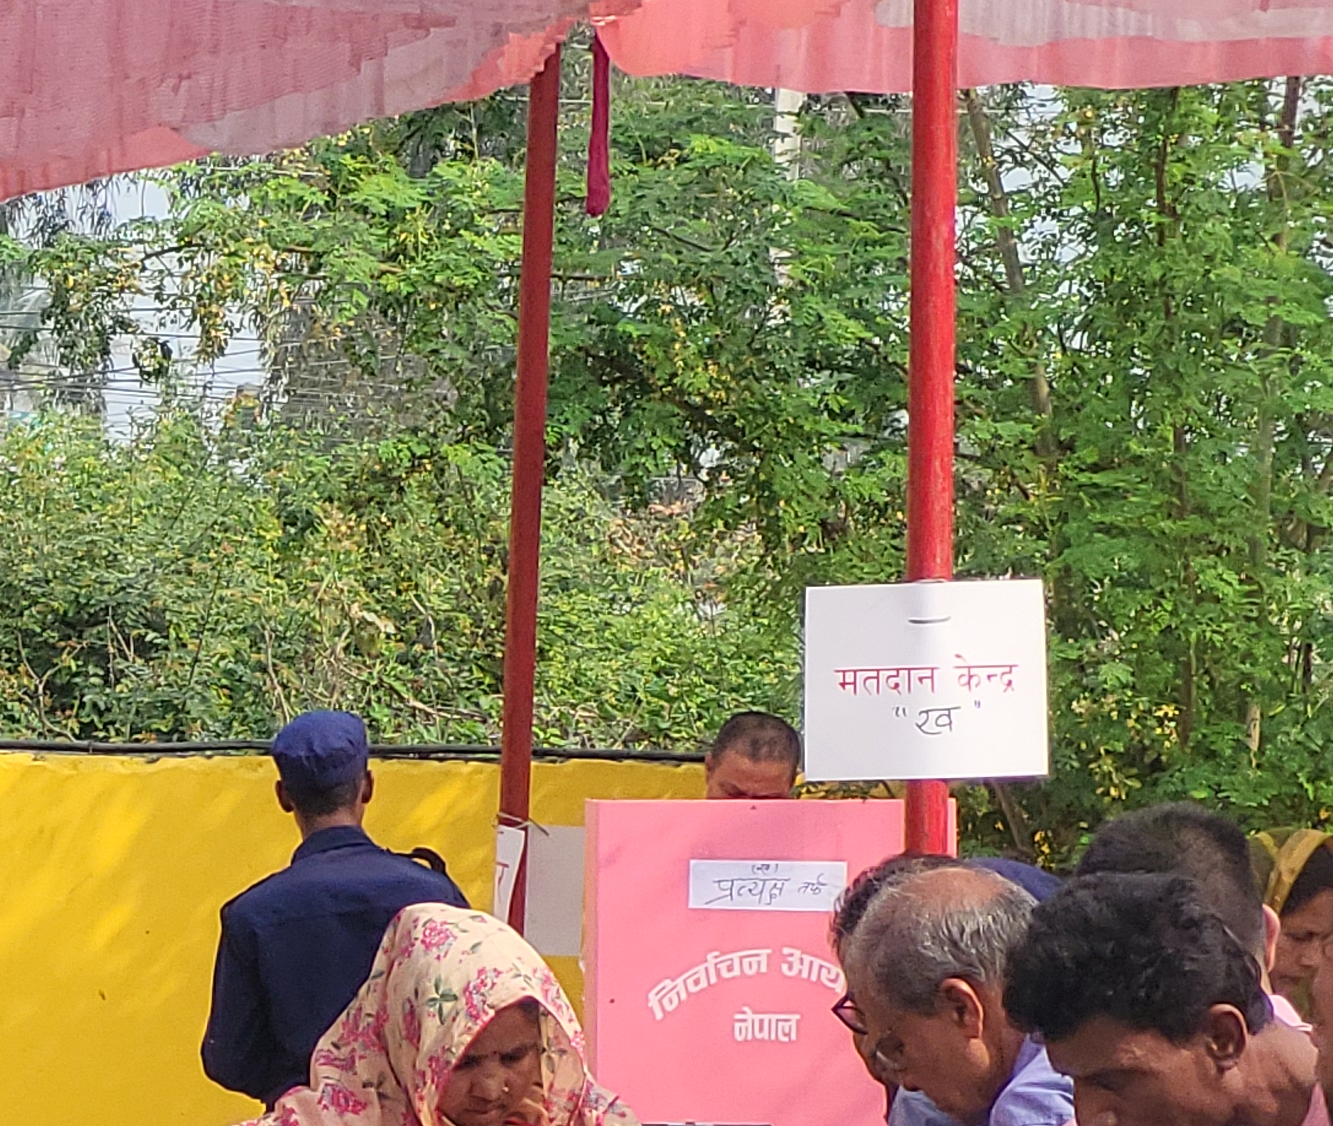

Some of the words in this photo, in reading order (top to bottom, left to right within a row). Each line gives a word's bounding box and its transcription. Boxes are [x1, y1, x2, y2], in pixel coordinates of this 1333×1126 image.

[834, 666, 939, 696] मतदान
[953, 653, 1019, 692] केन्द्र
[704, 877, 791, 905] प्रत्यक्ष
[797, 873, 828, 895] तर्फ
[648, 949, 772, 1021] निर्वाचन
[734, 1006, 800, 1042] नेपाल
